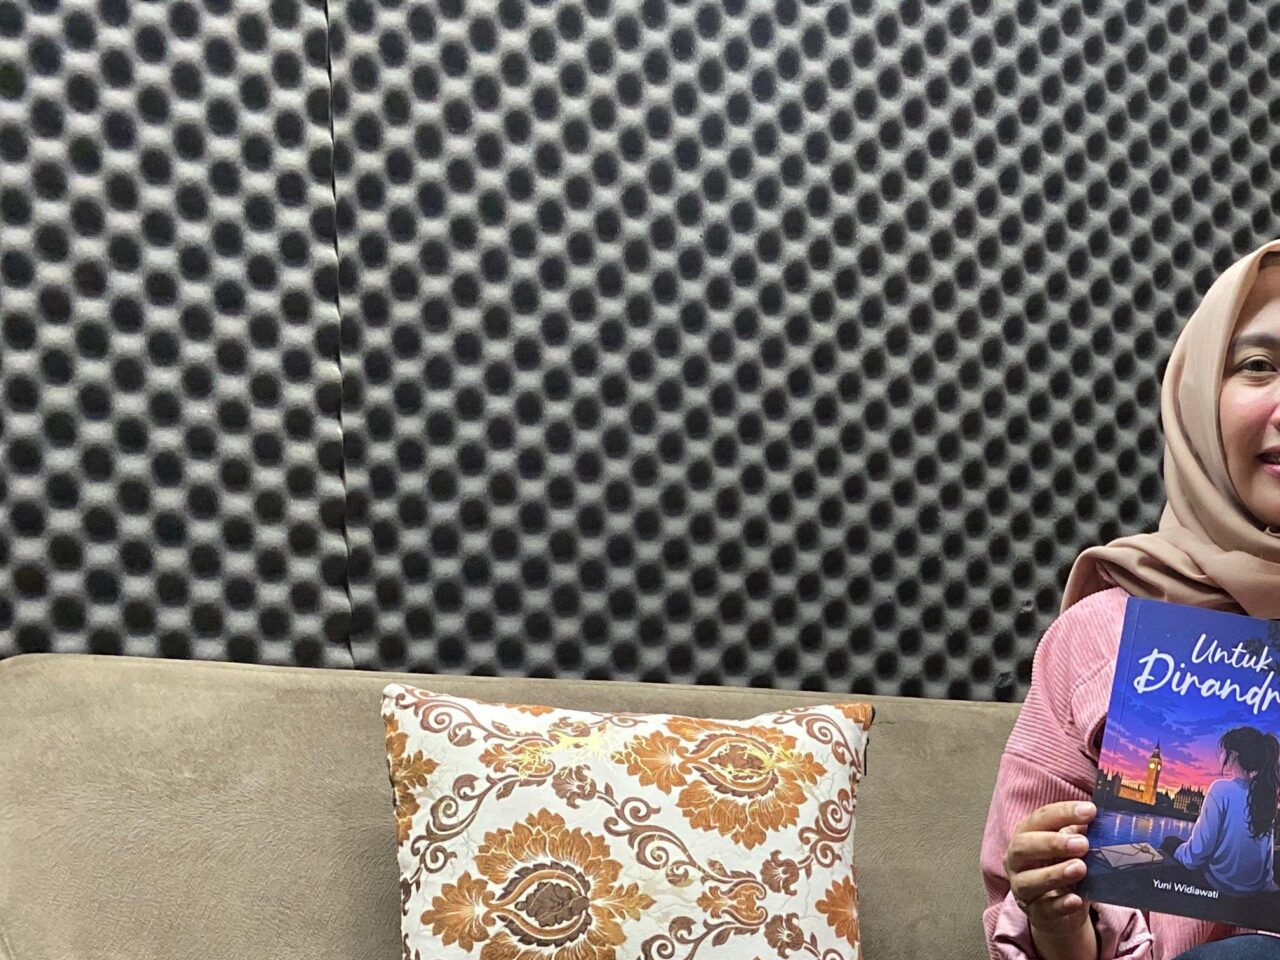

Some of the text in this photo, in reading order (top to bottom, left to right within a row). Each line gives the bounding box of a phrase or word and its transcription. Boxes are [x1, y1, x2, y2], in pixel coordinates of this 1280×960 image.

[1191, 633, 1272, 672] Untuk
[1153, 878, 1219, 899] Yuni Widiawati
